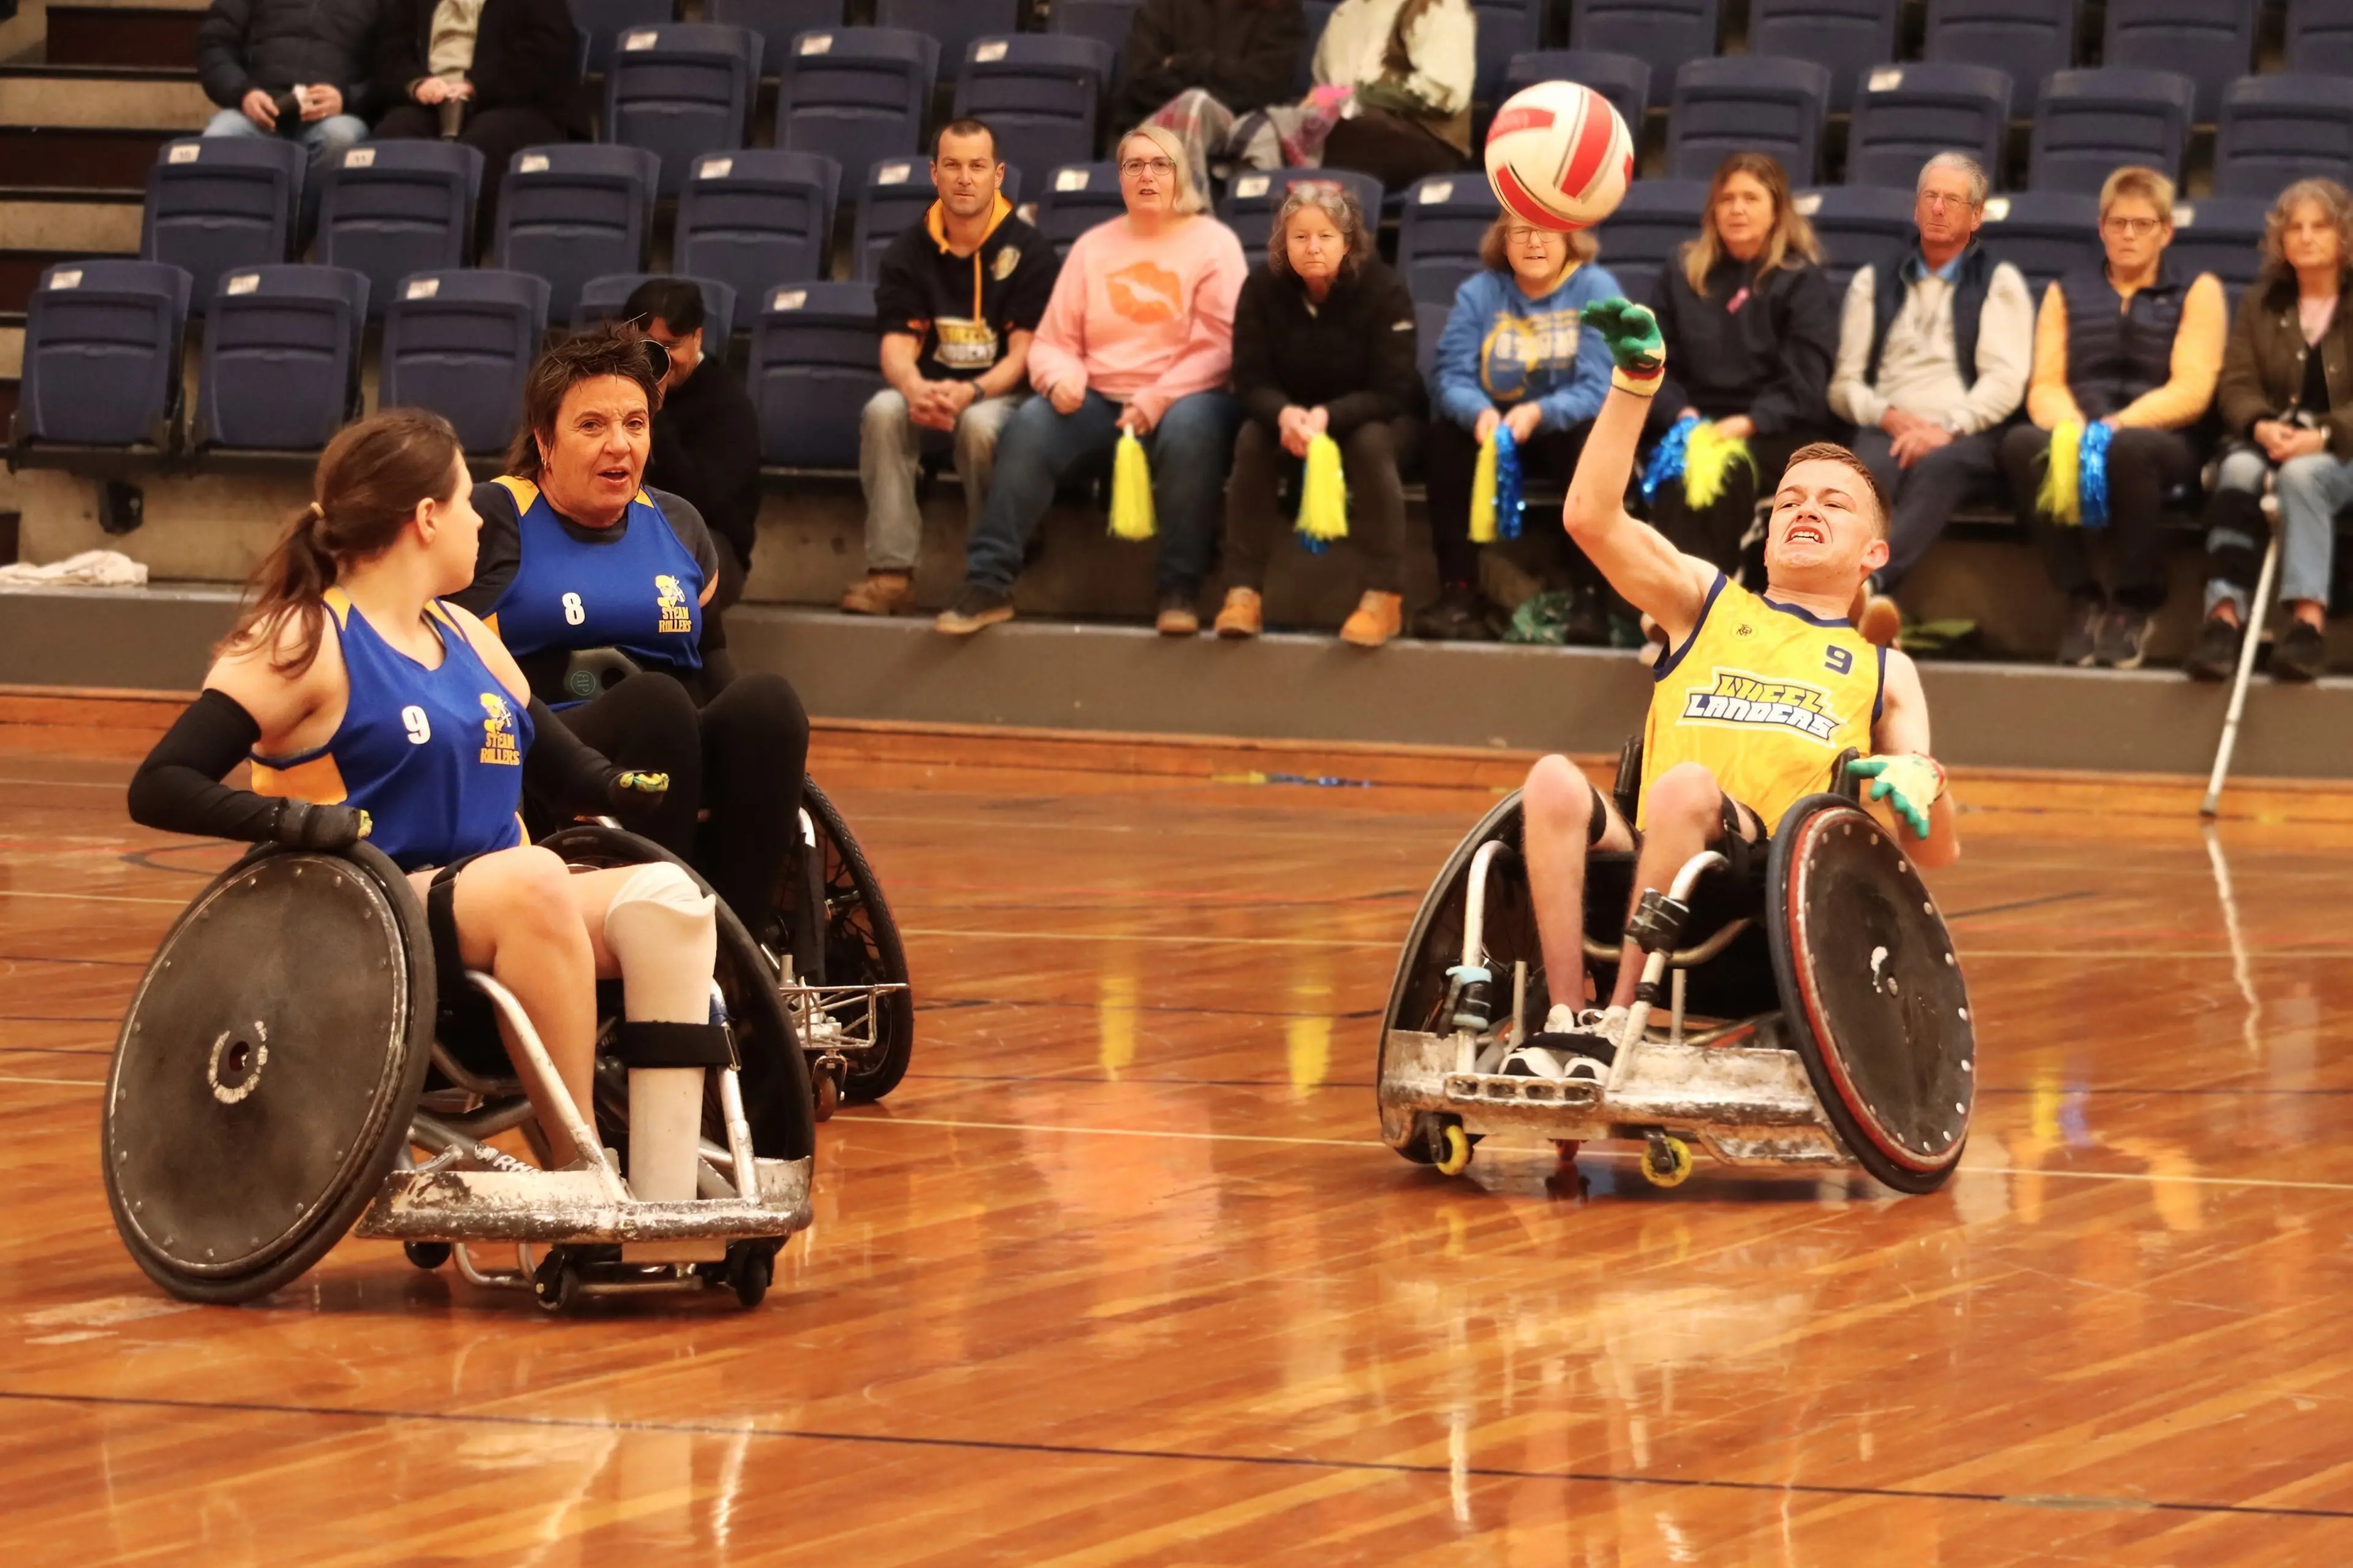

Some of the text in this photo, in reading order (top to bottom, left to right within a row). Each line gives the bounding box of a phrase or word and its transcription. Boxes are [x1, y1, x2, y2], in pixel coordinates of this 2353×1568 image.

[561, 592, 586, 626] 8
[662, 606, 689, 619] STEAM
[659, 619, 692, 633] ROLLERS
[1824, 645, 1853, 675] 9
[1714, 674, 1824, 713] WHEEL
[401, 705, 431, 744] 9
[1683, 693, 1840, 740] LANDERS
[485, 732, 515, 749] STEAM
[480, 748, 520, 766] ROLLERS
